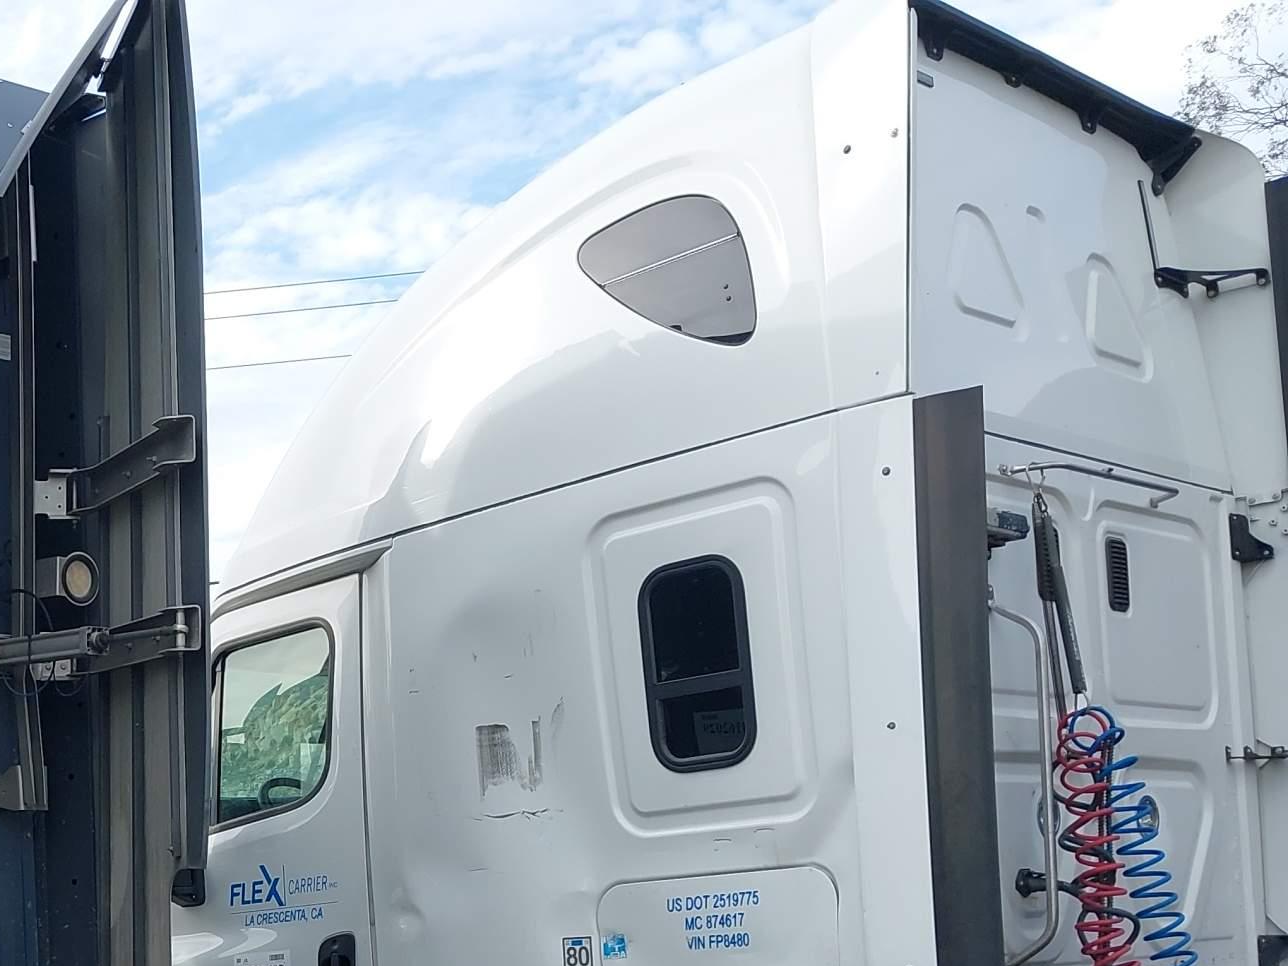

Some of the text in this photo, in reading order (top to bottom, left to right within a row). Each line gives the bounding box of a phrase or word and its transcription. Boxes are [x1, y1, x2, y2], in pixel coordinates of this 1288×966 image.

[230, 865, 286, 907] FLEX
[288, 875, 328, 895] CARRIER
[666, 890, 759, 913] US DOT 2519775
[245, 907, 324, 927] LA CRESCENTA, CA
[685, 913, 745, 931] MC 874617
[687, 932, 750, 950] VIN FP8480
[567, 946, 590, 966] 80
